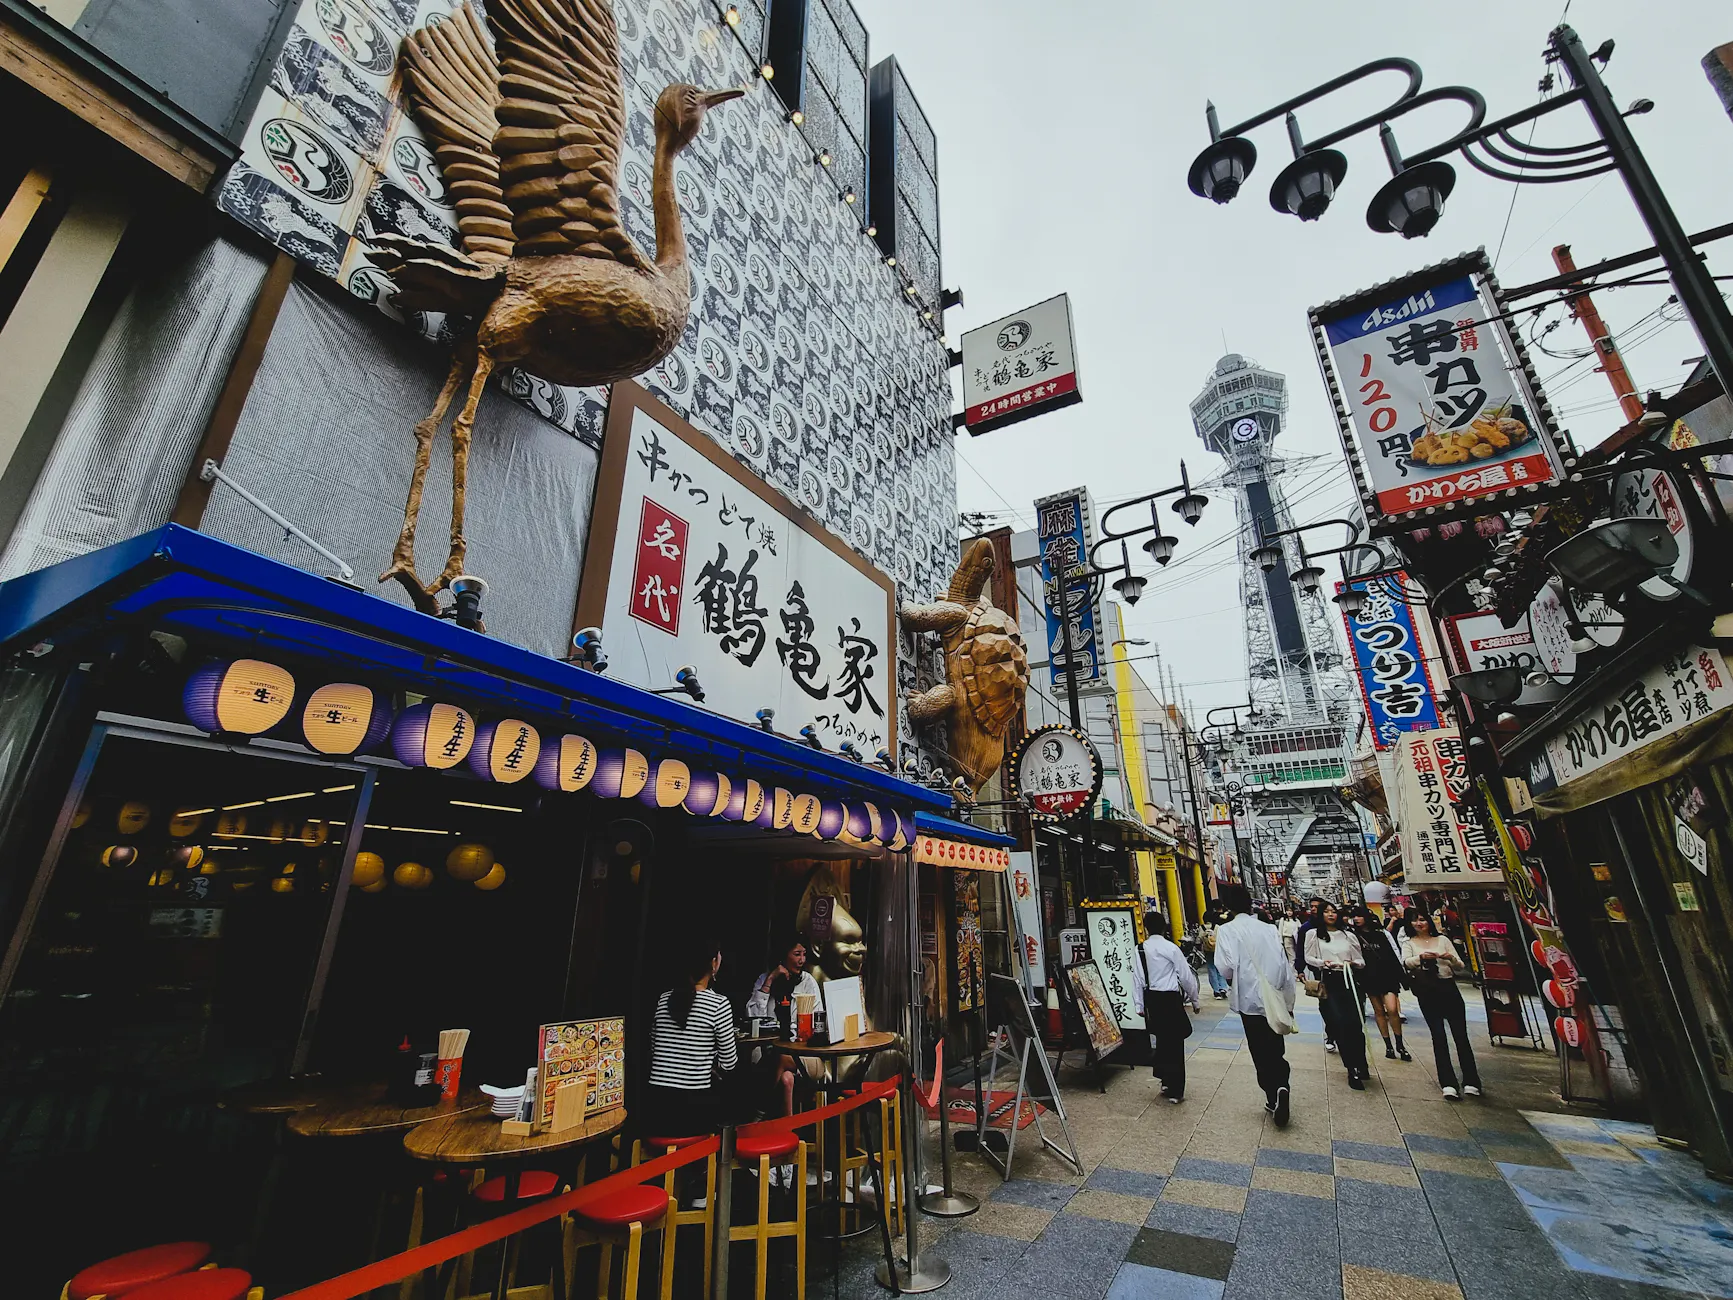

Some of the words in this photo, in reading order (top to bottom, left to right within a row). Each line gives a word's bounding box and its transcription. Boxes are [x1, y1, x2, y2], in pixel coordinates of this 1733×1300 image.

[1362, 290, 1436, 331] Asahi
[981, 382, 1057, 417] 24時間営業中
[992, 351, 1059, 386] 鶴亀家
[1386, 319, 1487, 433] 串カツ
[637, 429, 709, 505] 牛かつ
[719, 492, 777, 556] どて焼
[1406, 465, 1510, 504] かわち屋
[639, 518, 682, 622] 名代
[692, 542, 885, 719] 鶴亀家
[1356, 622, 1425, 718] つり吉
[1698, 651, 1723, 691] 名物
[815, 713, 882, 747] つるかめや
[1565, 680, 1662, 769] かわち屋
[1652, 687, 1674, 726] 本店
[1104, 947, 1132, 1021] 鶴亀家
